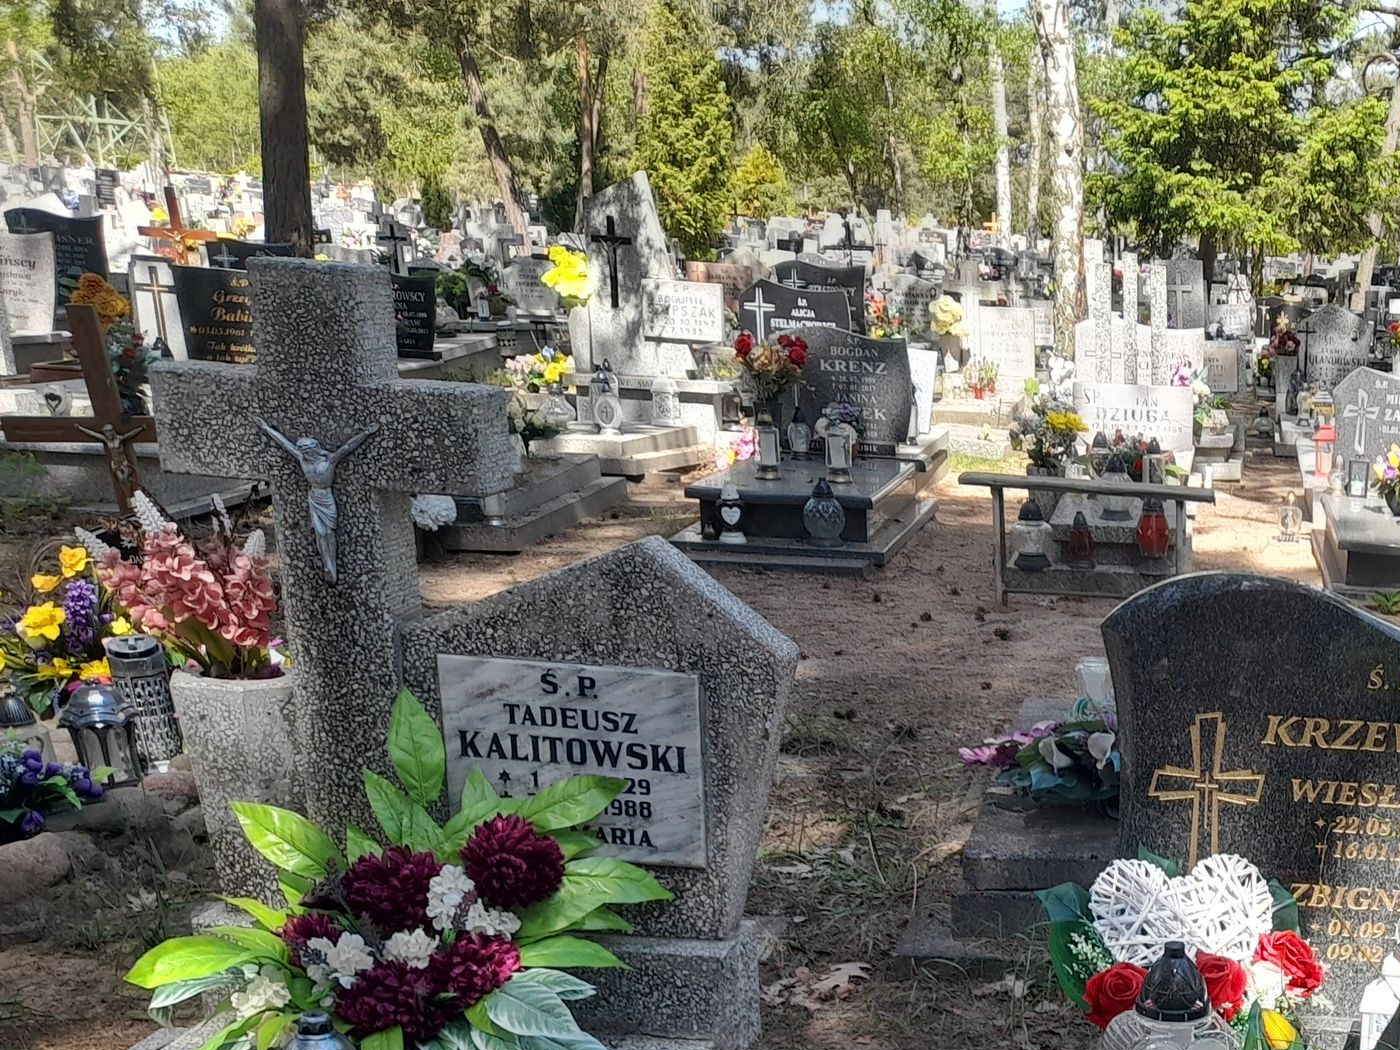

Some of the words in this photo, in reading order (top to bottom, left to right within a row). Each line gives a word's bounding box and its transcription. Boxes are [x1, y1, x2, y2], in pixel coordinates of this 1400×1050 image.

[830, 345, 879, 358] BOGDAN
[820, 359, 888, 375] KRENZ
[502, 702, 639, 735] TADEUSZ
[456, 729, 687, 774] KALITOWSKI
